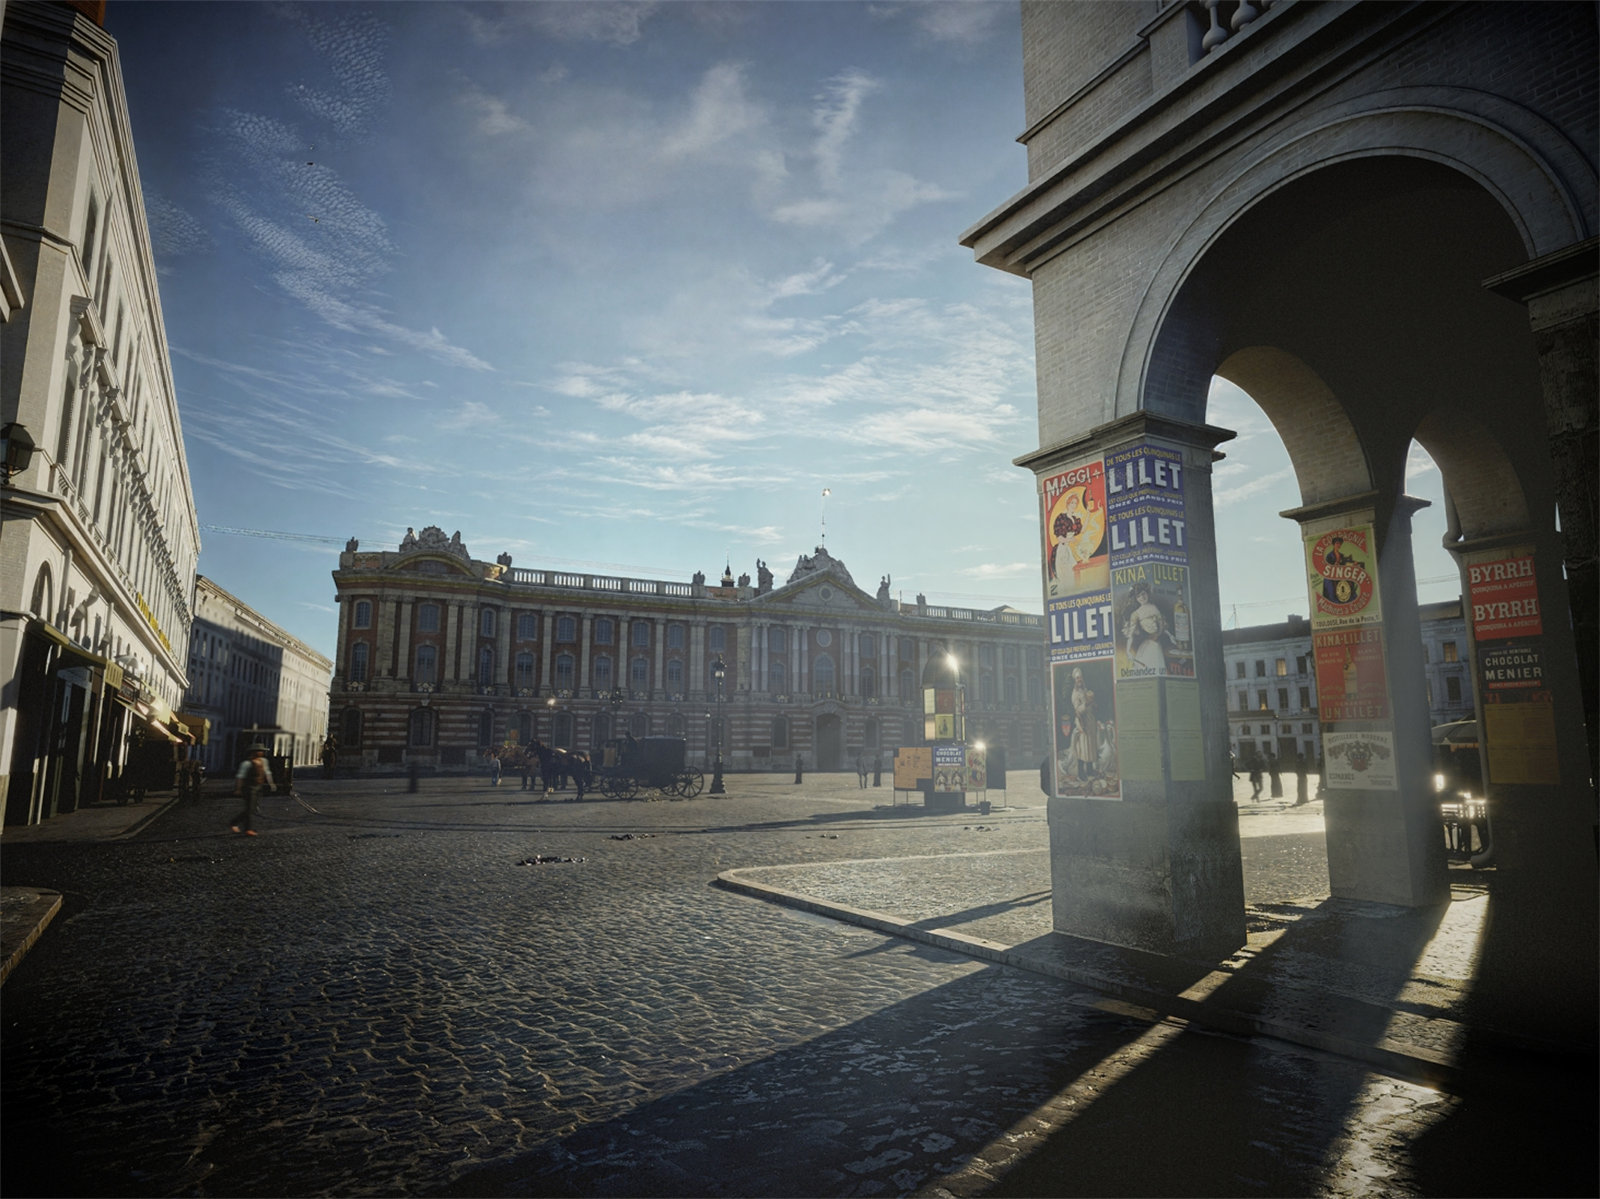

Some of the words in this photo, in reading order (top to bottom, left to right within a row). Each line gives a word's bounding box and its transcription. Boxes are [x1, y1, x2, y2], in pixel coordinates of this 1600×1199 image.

[1115, 452, 1132, 463] TOUS
[1132, 447, 1143, 458] LES
[1108, 457, 1181, 494] LILET
[1045, 466, 1092, 511] MAGGI
[1133, 494, 1166, 503] GRANDS
[1166, 498, 1184, 506] PRIX
[1134, 506, 1146, 516] LES
[1111, 516, 1185, 551] LILET
[1314, 545, 1325, 556] LA
[1469, 559, 1533, 584] BYRRH
[1473, 597, 1538, 622] BYRRH
[1050, 604, 1112, 644] LILET
[1069, 650, 1096, 660] GRANDS
[1097, 648, 1114, 656] PRIX
[1485, 654, 1539, 667] CHOCOLAT
[1485, 666, 1543, 681] MENIER
[1345, 705, 1383, 718] LILET
